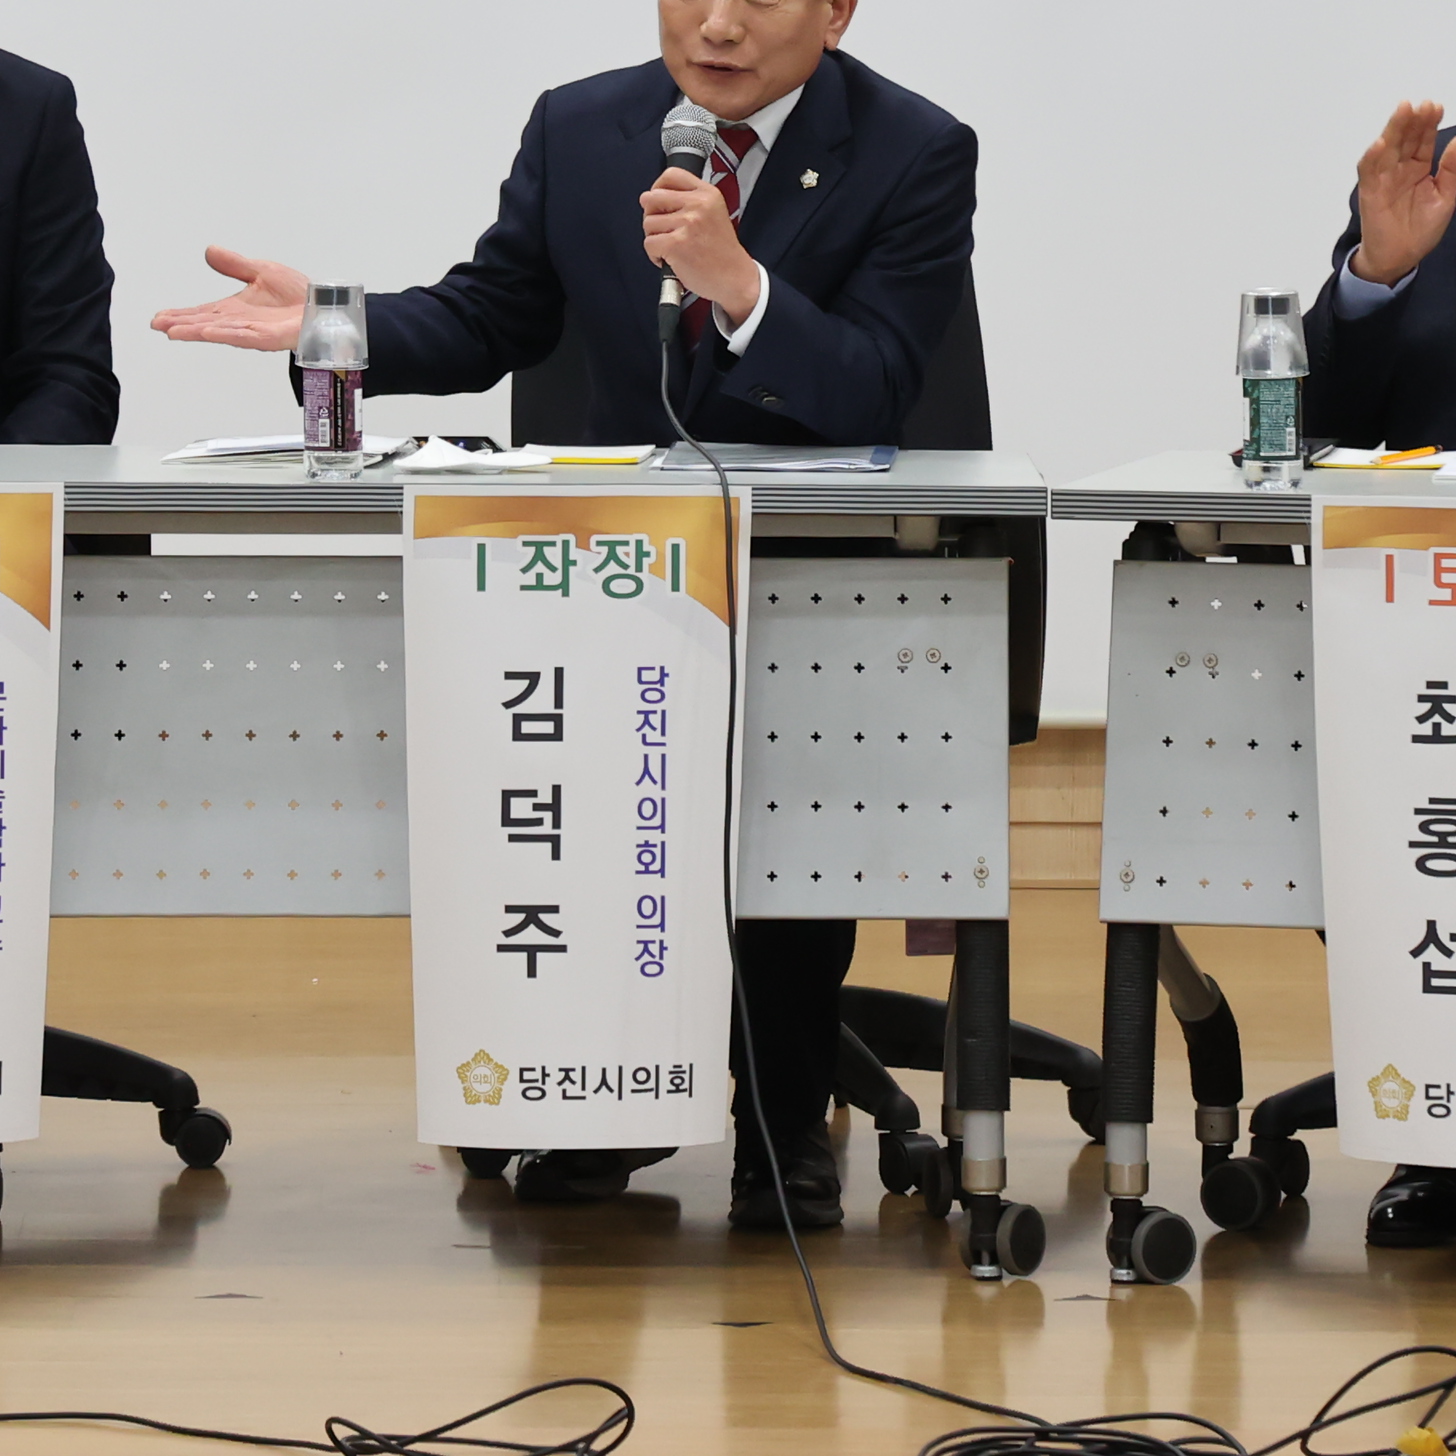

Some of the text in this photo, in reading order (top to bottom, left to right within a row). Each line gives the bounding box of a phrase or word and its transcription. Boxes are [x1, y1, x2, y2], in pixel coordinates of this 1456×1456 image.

[519, 539, 652, 599] 좌장
[634, 665, 670, 978] 당진시의회 의장
[518, 1062, 694, 1102] 당진시의회
